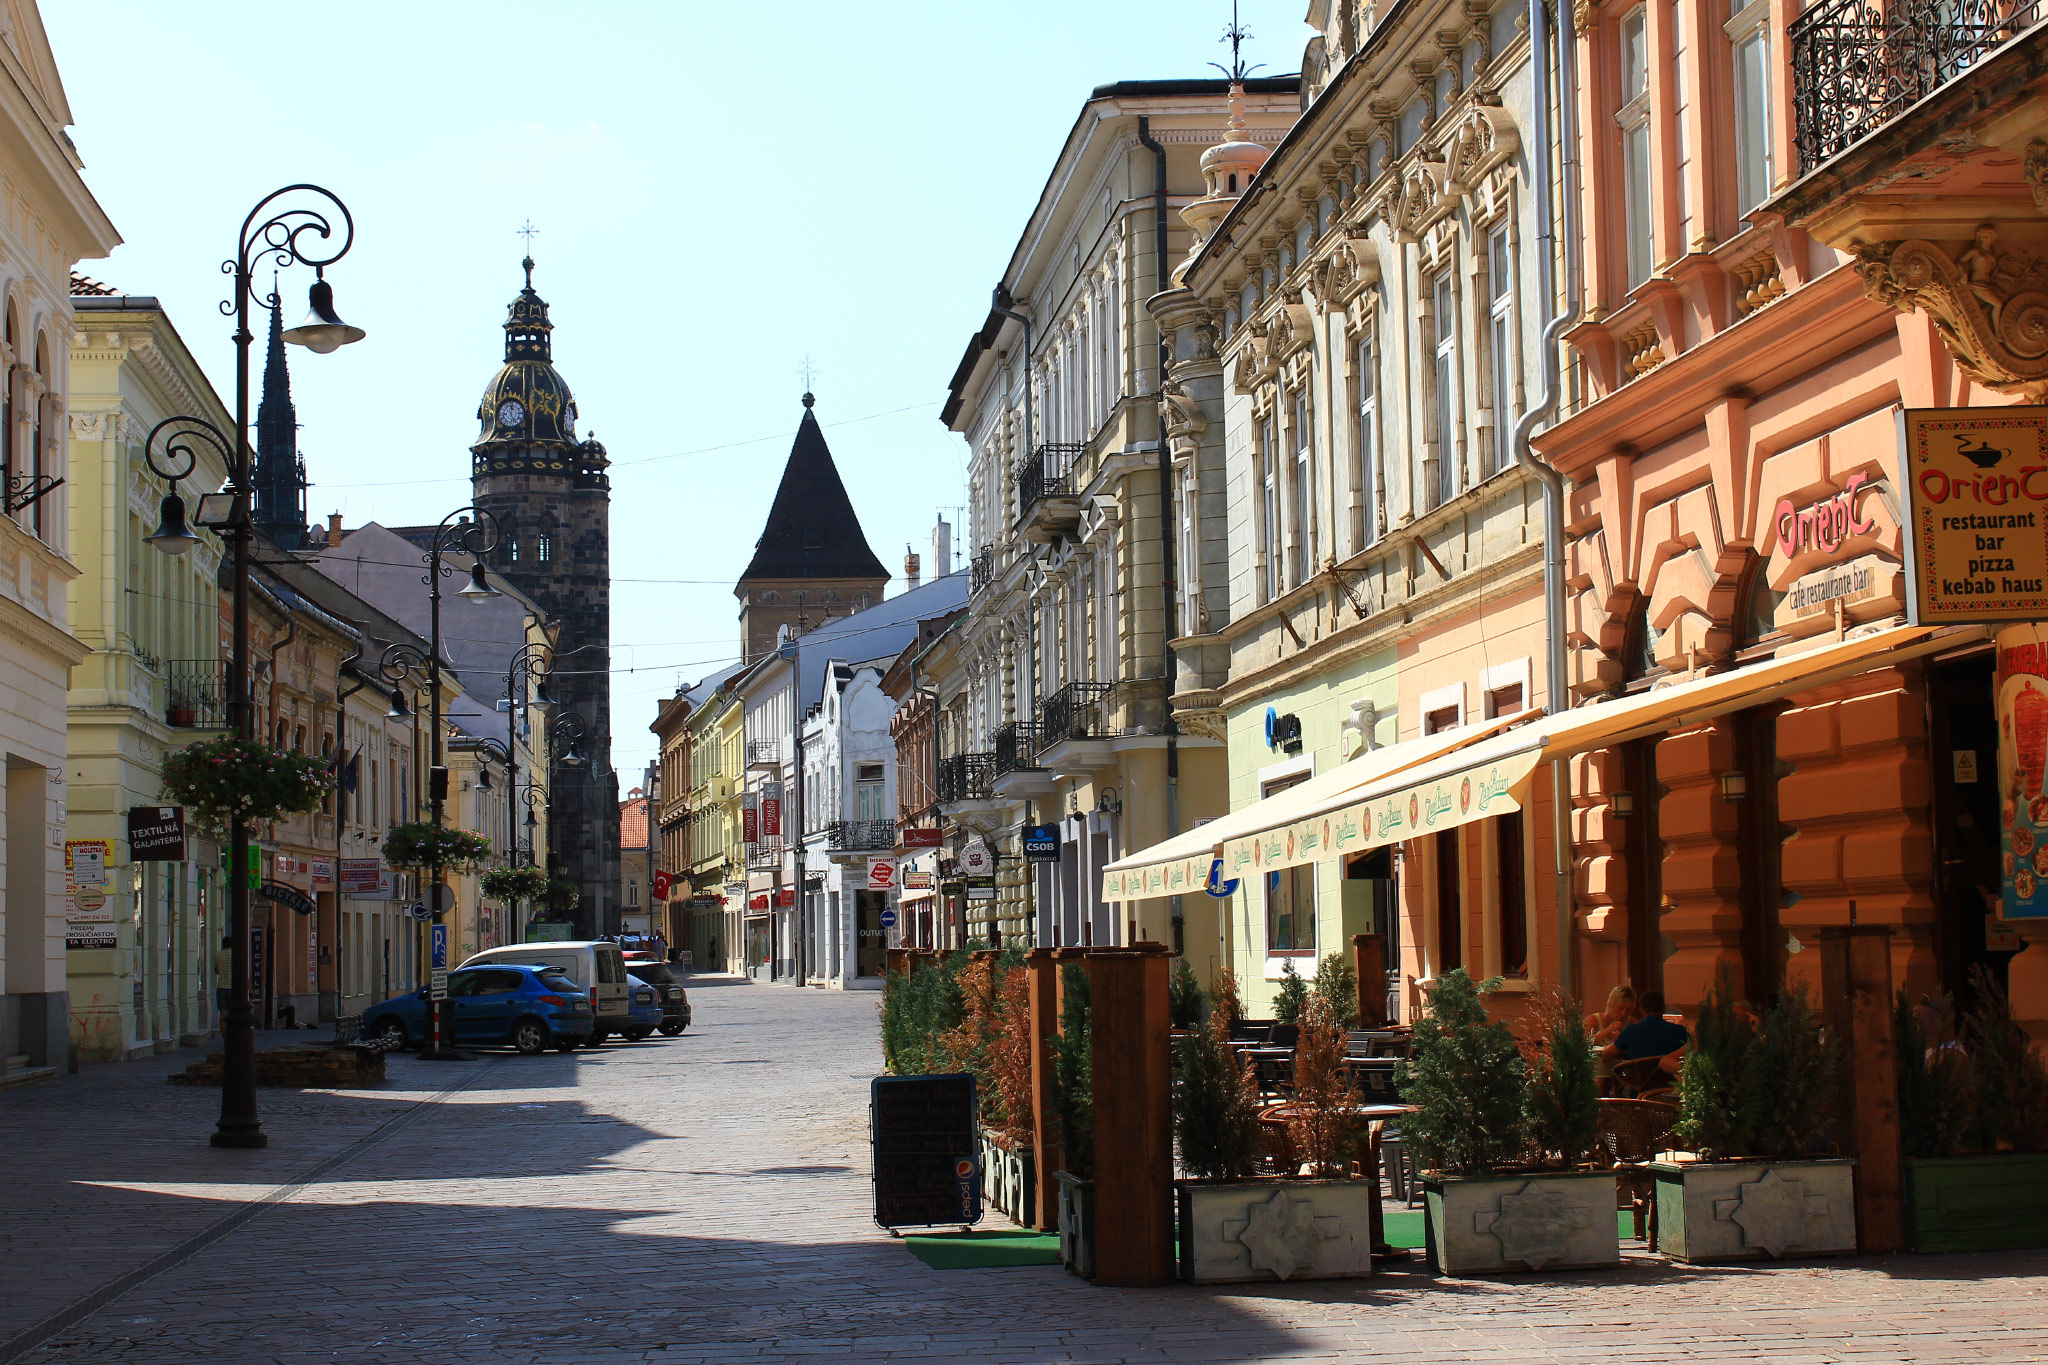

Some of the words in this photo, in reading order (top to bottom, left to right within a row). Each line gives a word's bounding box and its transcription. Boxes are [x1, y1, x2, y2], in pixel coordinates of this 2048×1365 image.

[1919, 465, 2048, 505] Orient
[1776, 470, 1875, 559] Orient
[1942, 512, 2035, 530] restaurant
[1975, 534, 2005, 551] bar
[1968, 555, 2015, 578] pizza
[1807, 573, 1852, 605] restaurante
[1853, 564, 1870, 591] bar
[1943, 577, 1996, 595] kebab
[2002, 576, 2043, 594] haus
[131, 821, 180, 839] TEXTILNÁ
[133, 835, 183, 849] GALANTÉRIA
[1026, 842, 1055, 852] ČSOB
[265, 885, 312, 913] BICYKLE
[959, 1181, 974, 1219] pepsi
